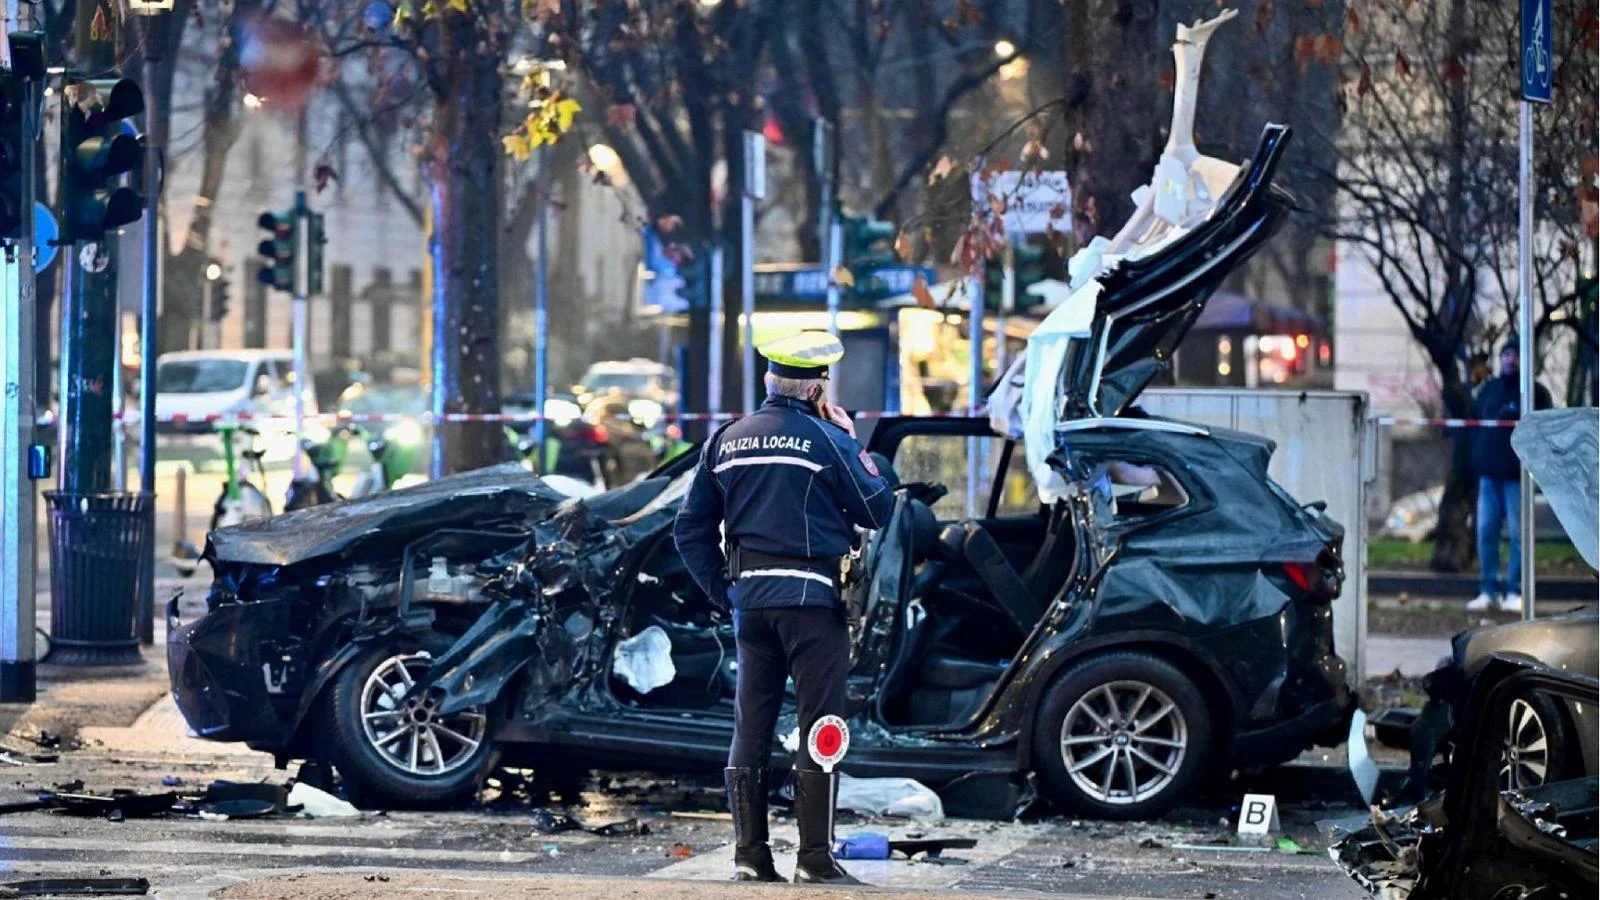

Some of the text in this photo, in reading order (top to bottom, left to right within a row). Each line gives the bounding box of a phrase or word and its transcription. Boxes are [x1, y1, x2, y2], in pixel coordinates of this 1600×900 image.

[719, 435, 812, 457] POLIZIA LOCALE
[810, 719, 825, 746] COMUNE
[835, 718, 848, 743] MILANO
[1246, 801, 1266, 825] B
